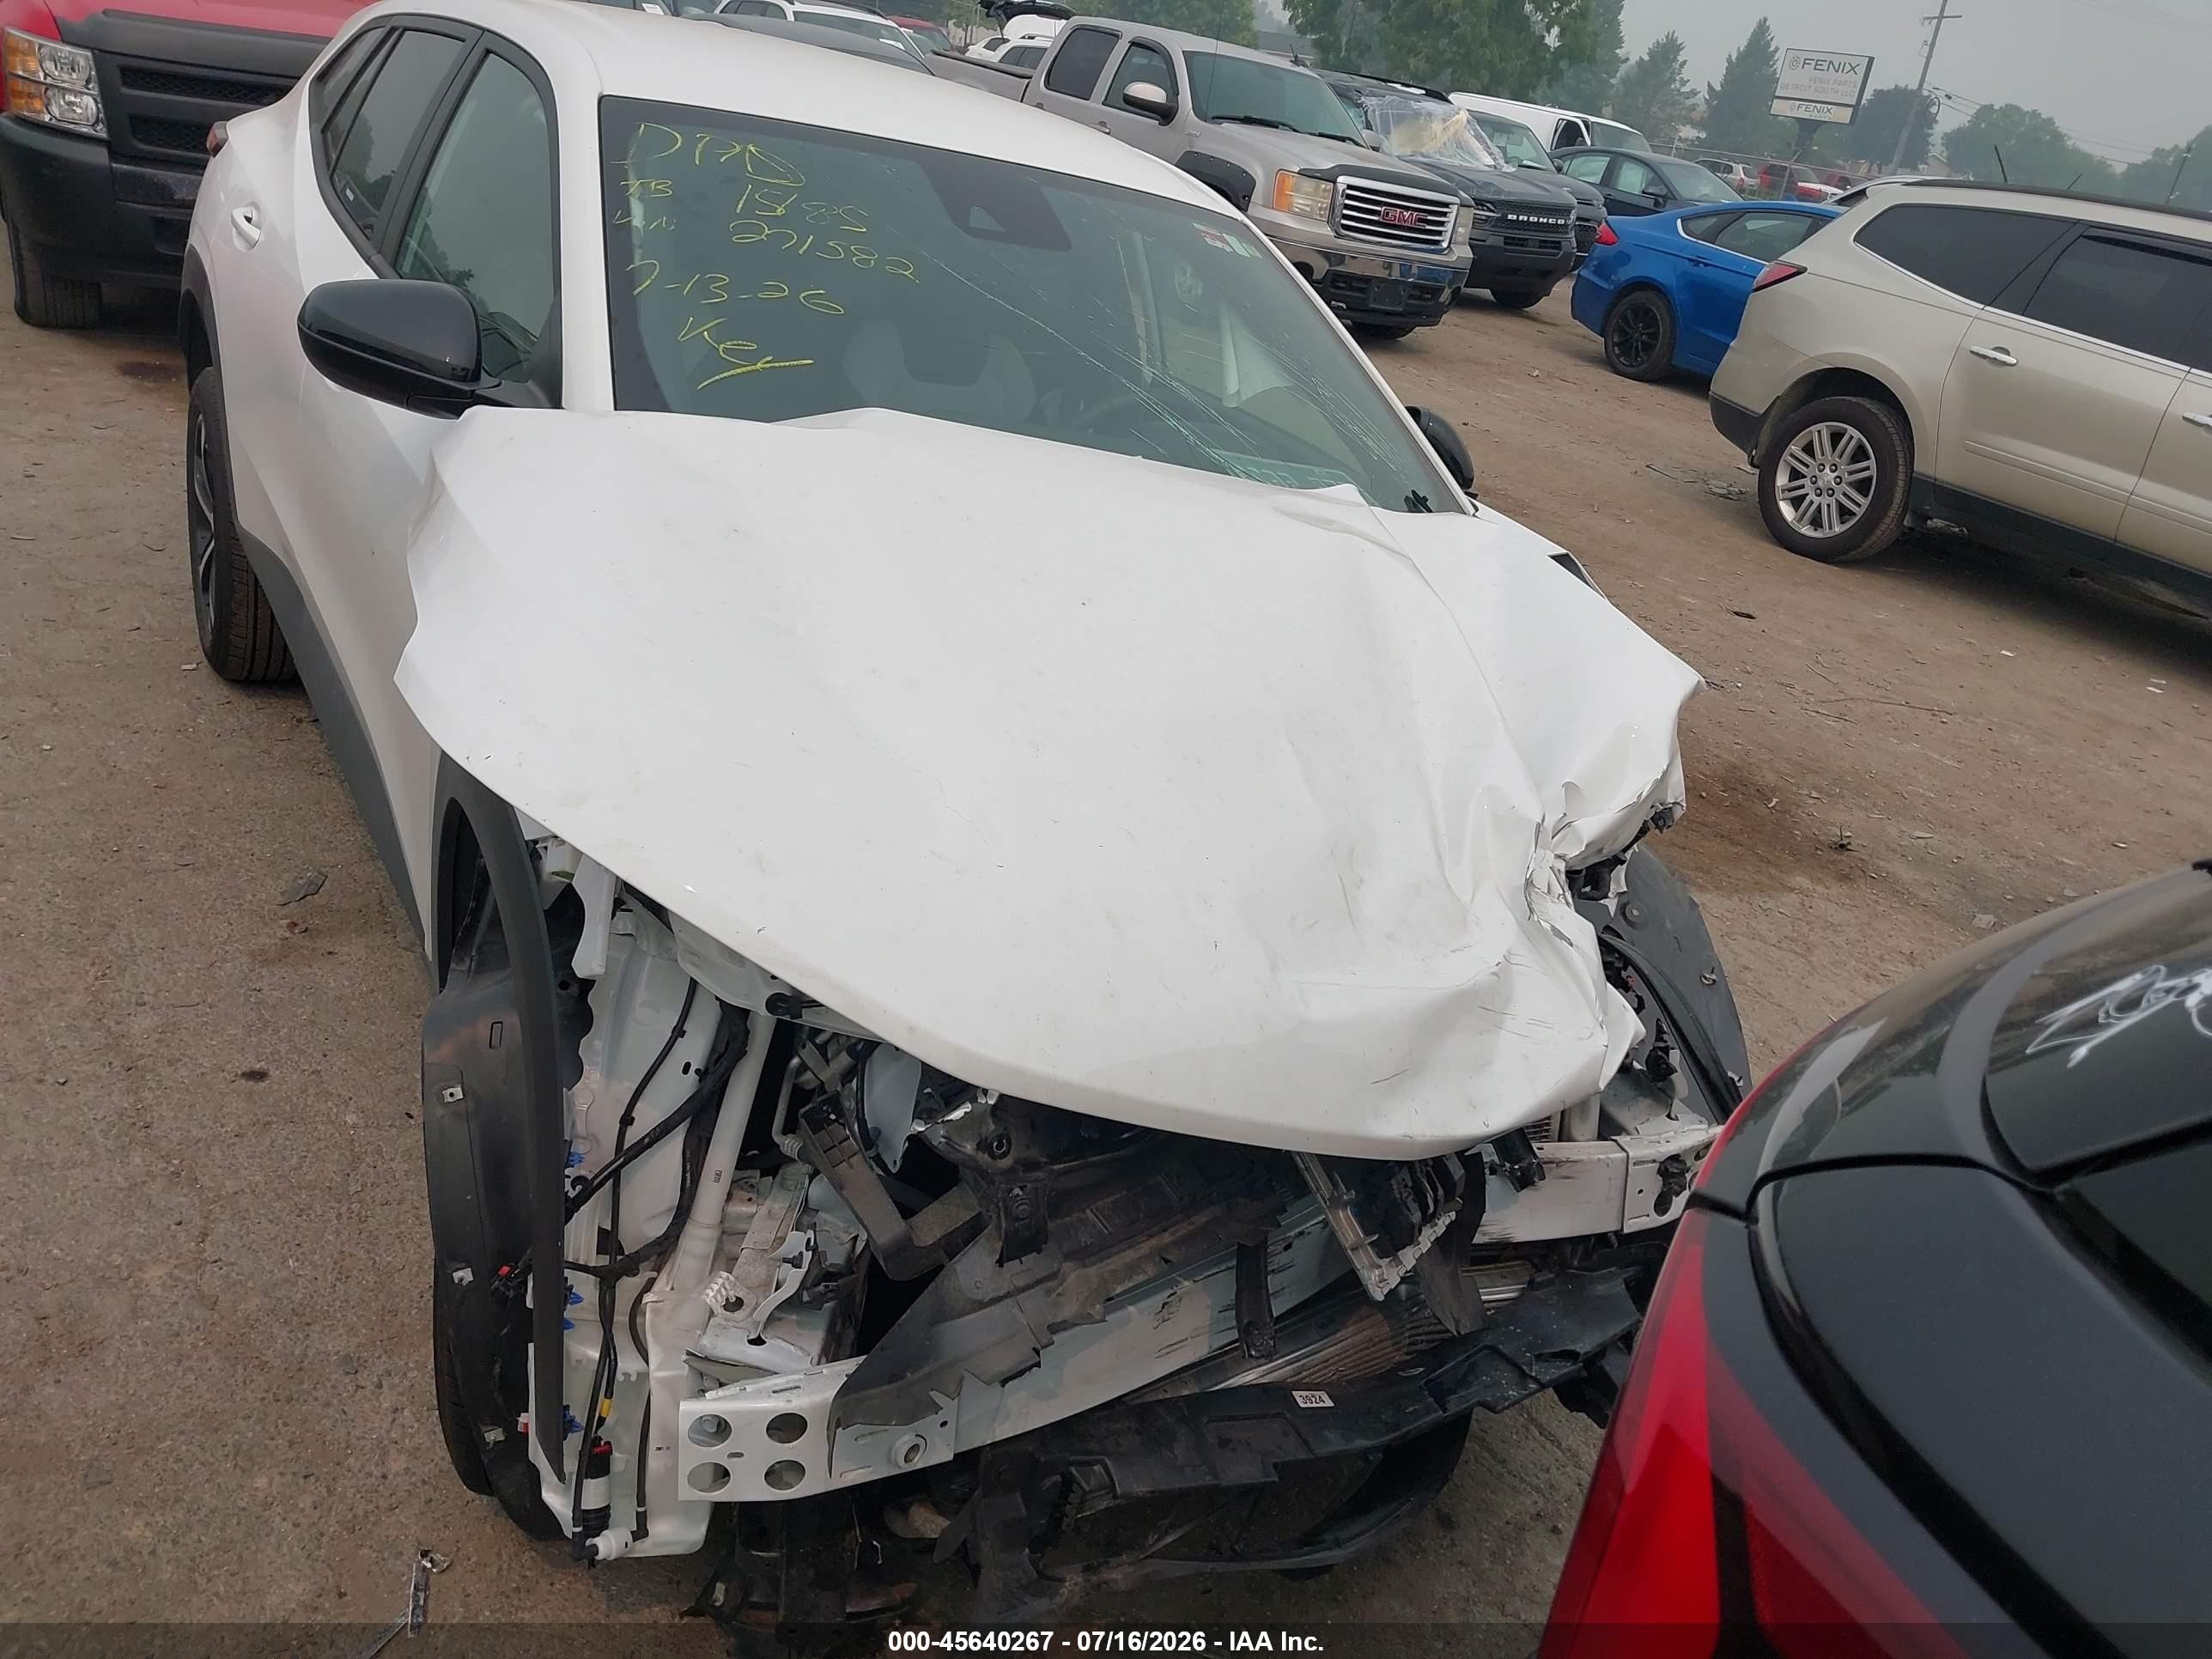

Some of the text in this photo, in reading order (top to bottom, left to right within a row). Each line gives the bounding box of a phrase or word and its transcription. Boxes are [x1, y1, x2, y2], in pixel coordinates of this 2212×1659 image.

[1801, 58, 1862, 76] FENIX
[1796, 103, 1834, 115] FENIX
[1379, 207, 1429, 229] GMC
[1507, 214, 1565, 225] BRONCO
[1298, 1395, 1327, 1405] 3924
